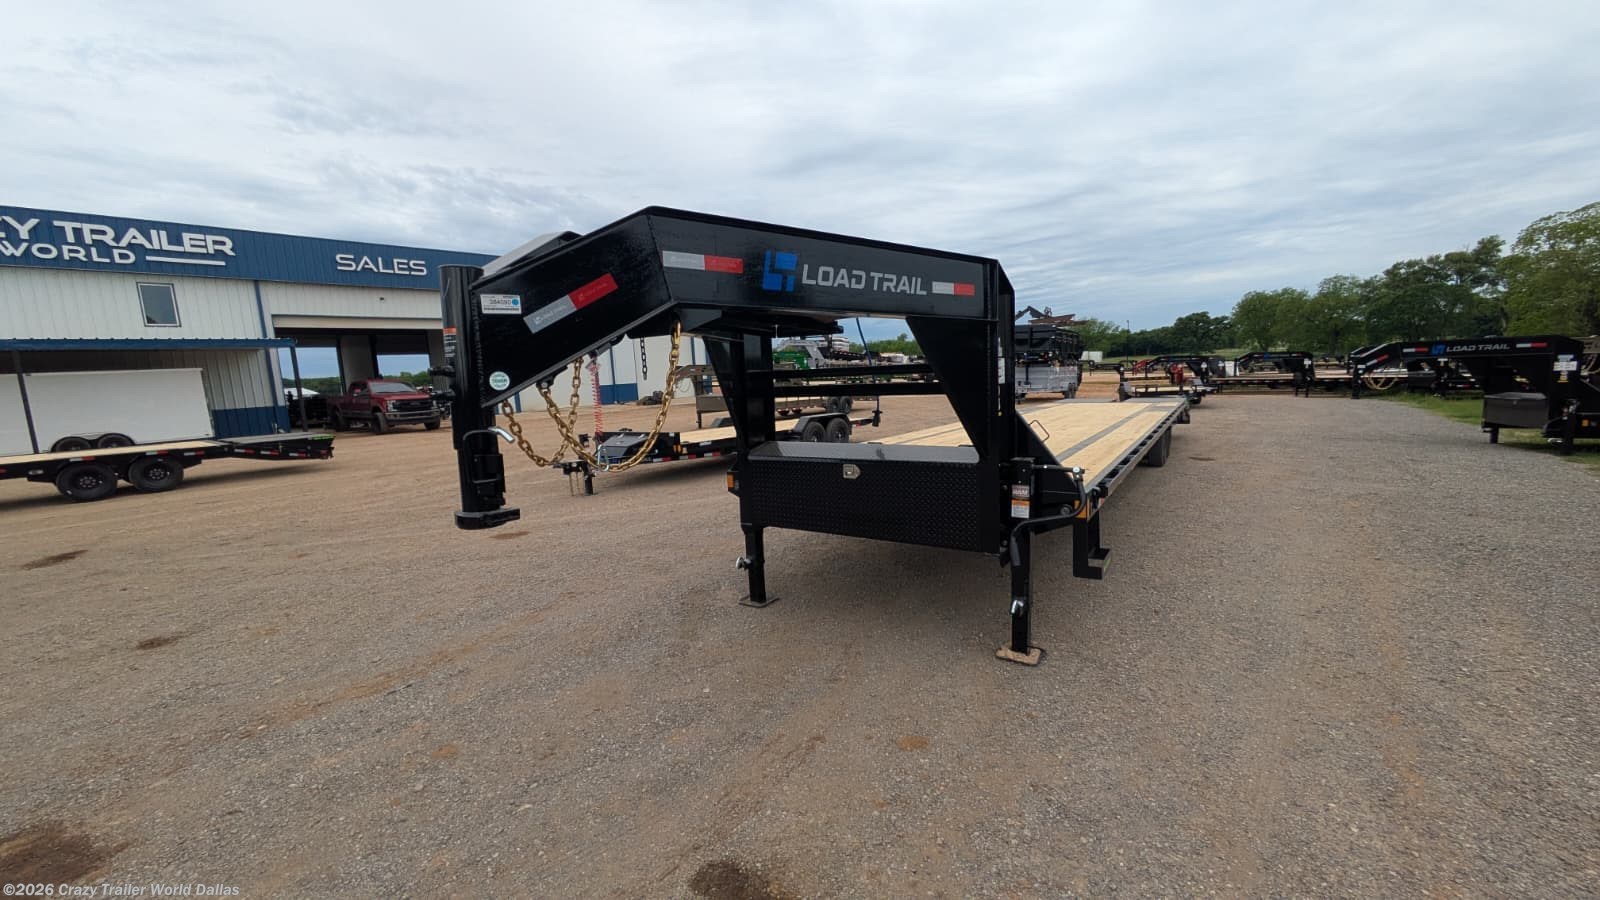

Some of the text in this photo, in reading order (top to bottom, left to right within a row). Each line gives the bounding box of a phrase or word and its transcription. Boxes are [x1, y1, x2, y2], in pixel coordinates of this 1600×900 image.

[0, 216, 236, 256] Y TRAILER
[0, 240, 136, 264] WORLD
[335, 253, 428, 276] SALES
[801, 263, 928, 296] LOAD TRAIL
[1446, 343, 1511, 353] LOAD TRAIL
